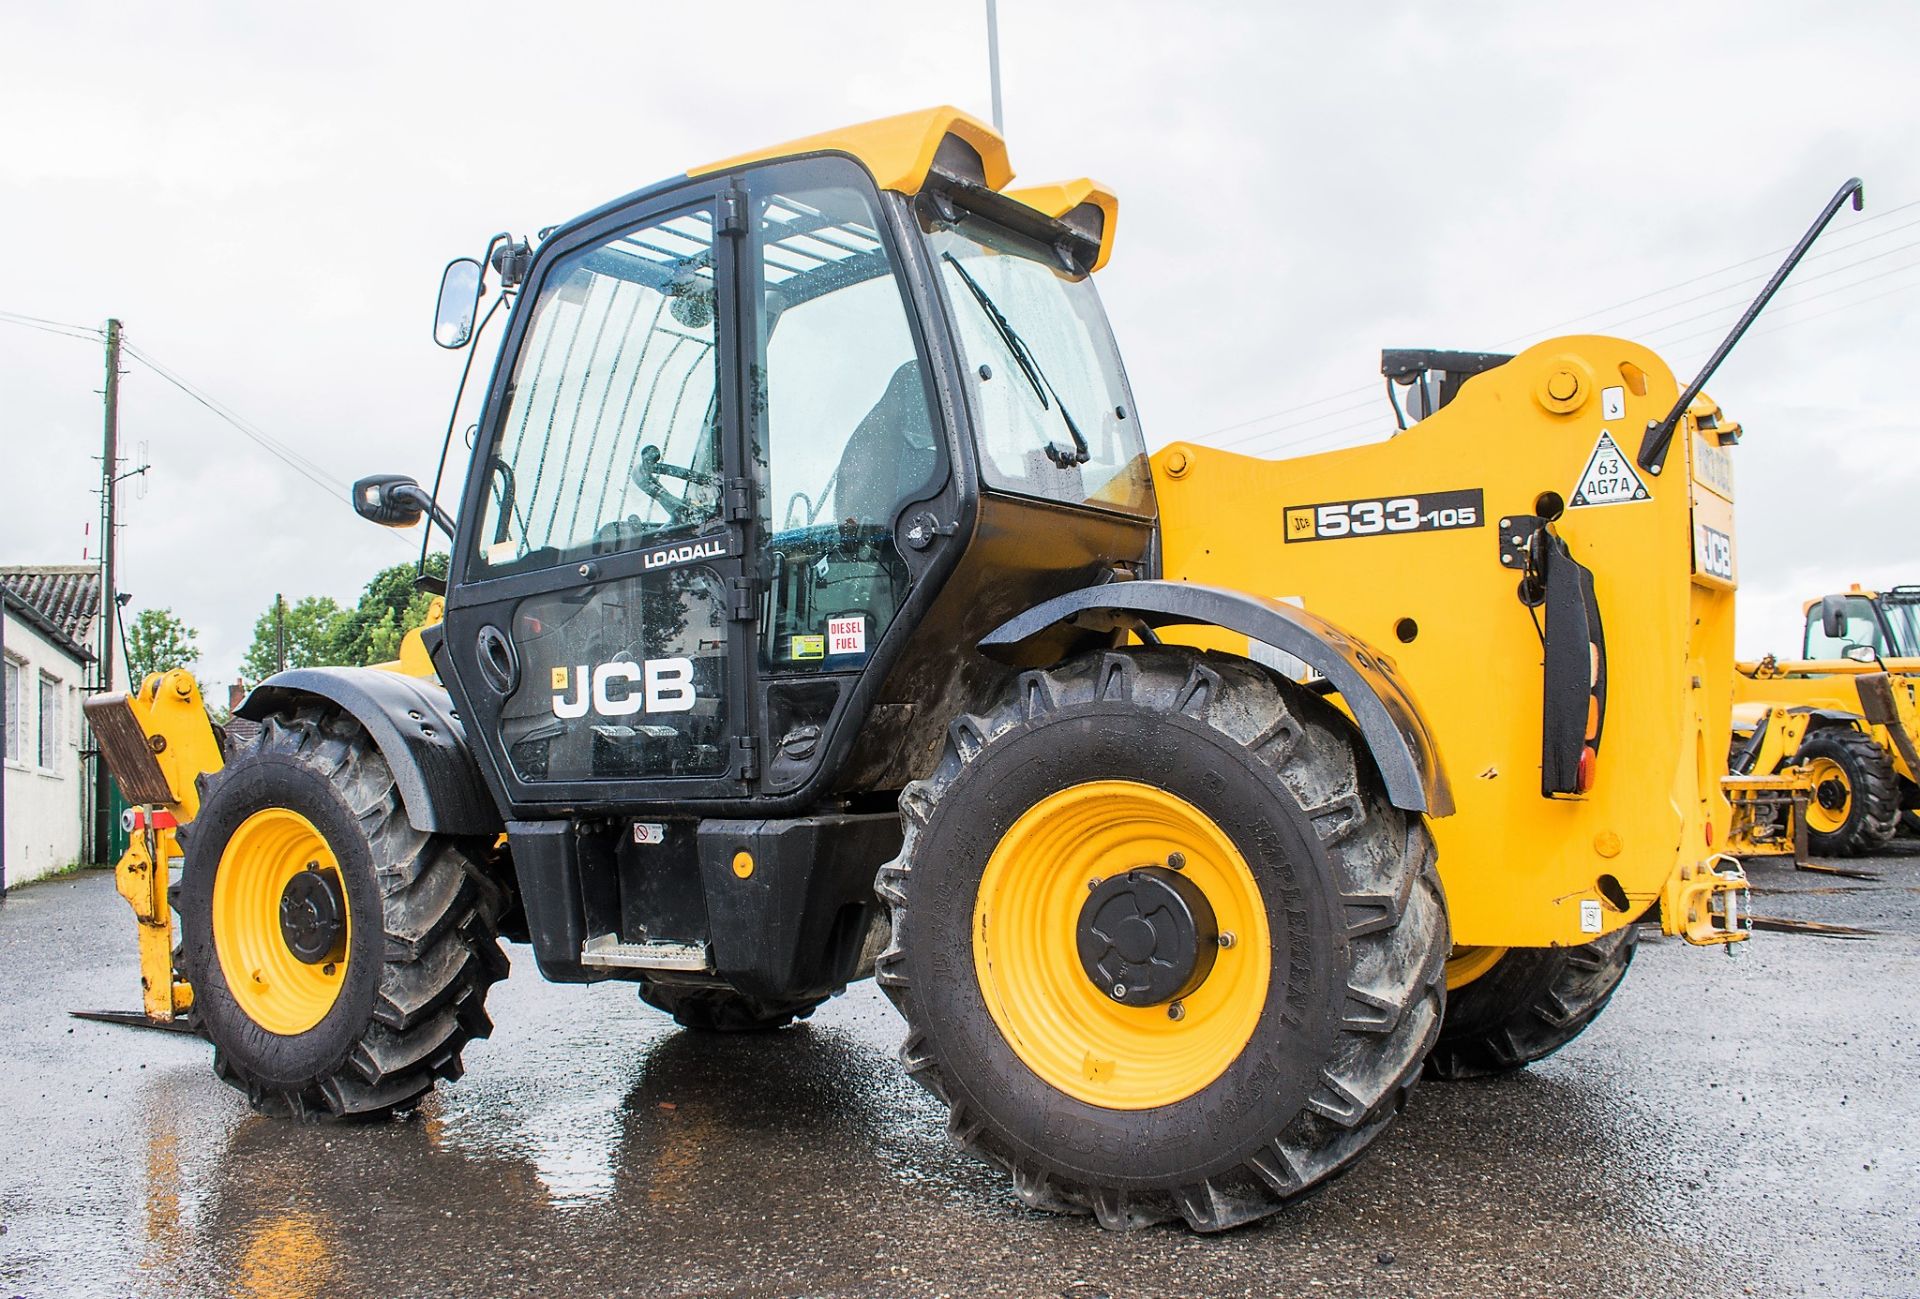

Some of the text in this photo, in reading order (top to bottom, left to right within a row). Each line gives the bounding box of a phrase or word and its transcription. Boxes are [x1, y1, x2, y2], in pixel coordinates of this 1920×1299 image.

[1598, 459, 1618, 475] 63
[1588, 477, 1630, 496] AG7A
[1294, 517, 1310, 531] JCB
[644, 541, 727, 569] LOADALL
[1704, 530, 1732, 577] JCB
[831, 621, 862, 635] DIESEL
[836, 637, 858, 650] FUEL
[552, 657, 697, 719] JCB
